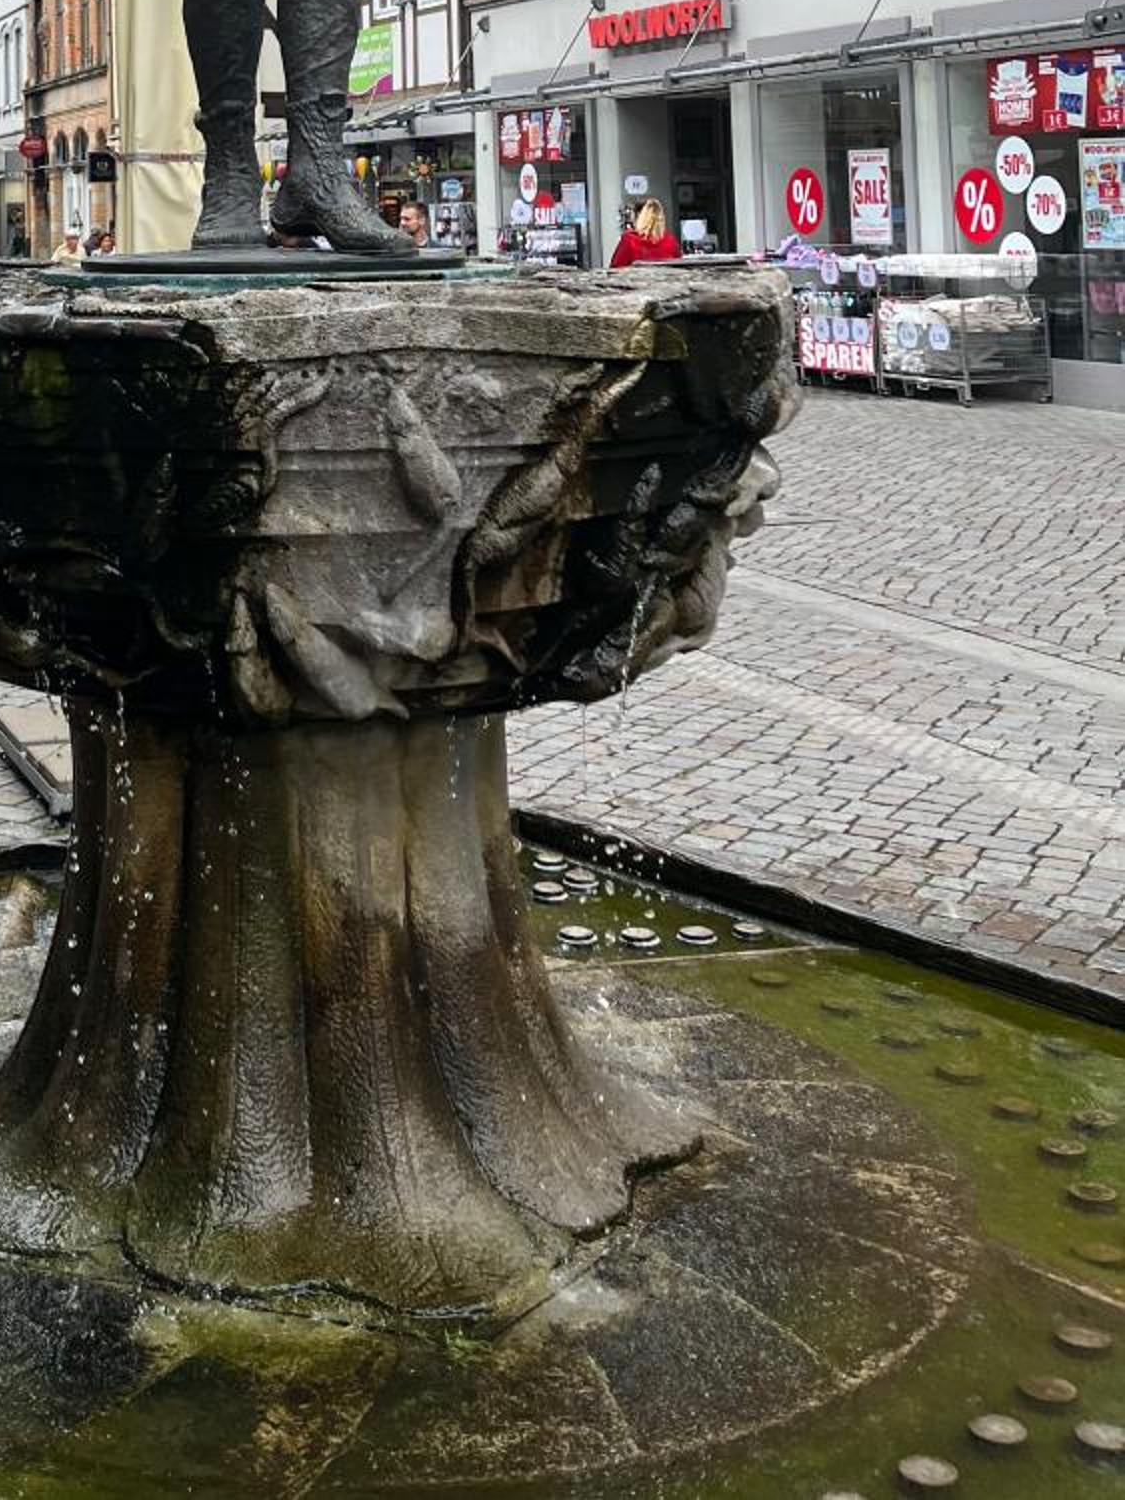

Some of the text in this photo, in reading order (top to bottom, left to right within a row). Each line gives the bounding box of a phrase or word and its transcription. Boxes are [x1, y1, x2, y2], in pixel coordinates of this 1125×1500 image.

[999, 154, 1031, 176] -50%
[855, 180, 886, 204] SALE
[1031, 193, 1062, 216] -70%
[802, 343, 874, 372] SPAREN
